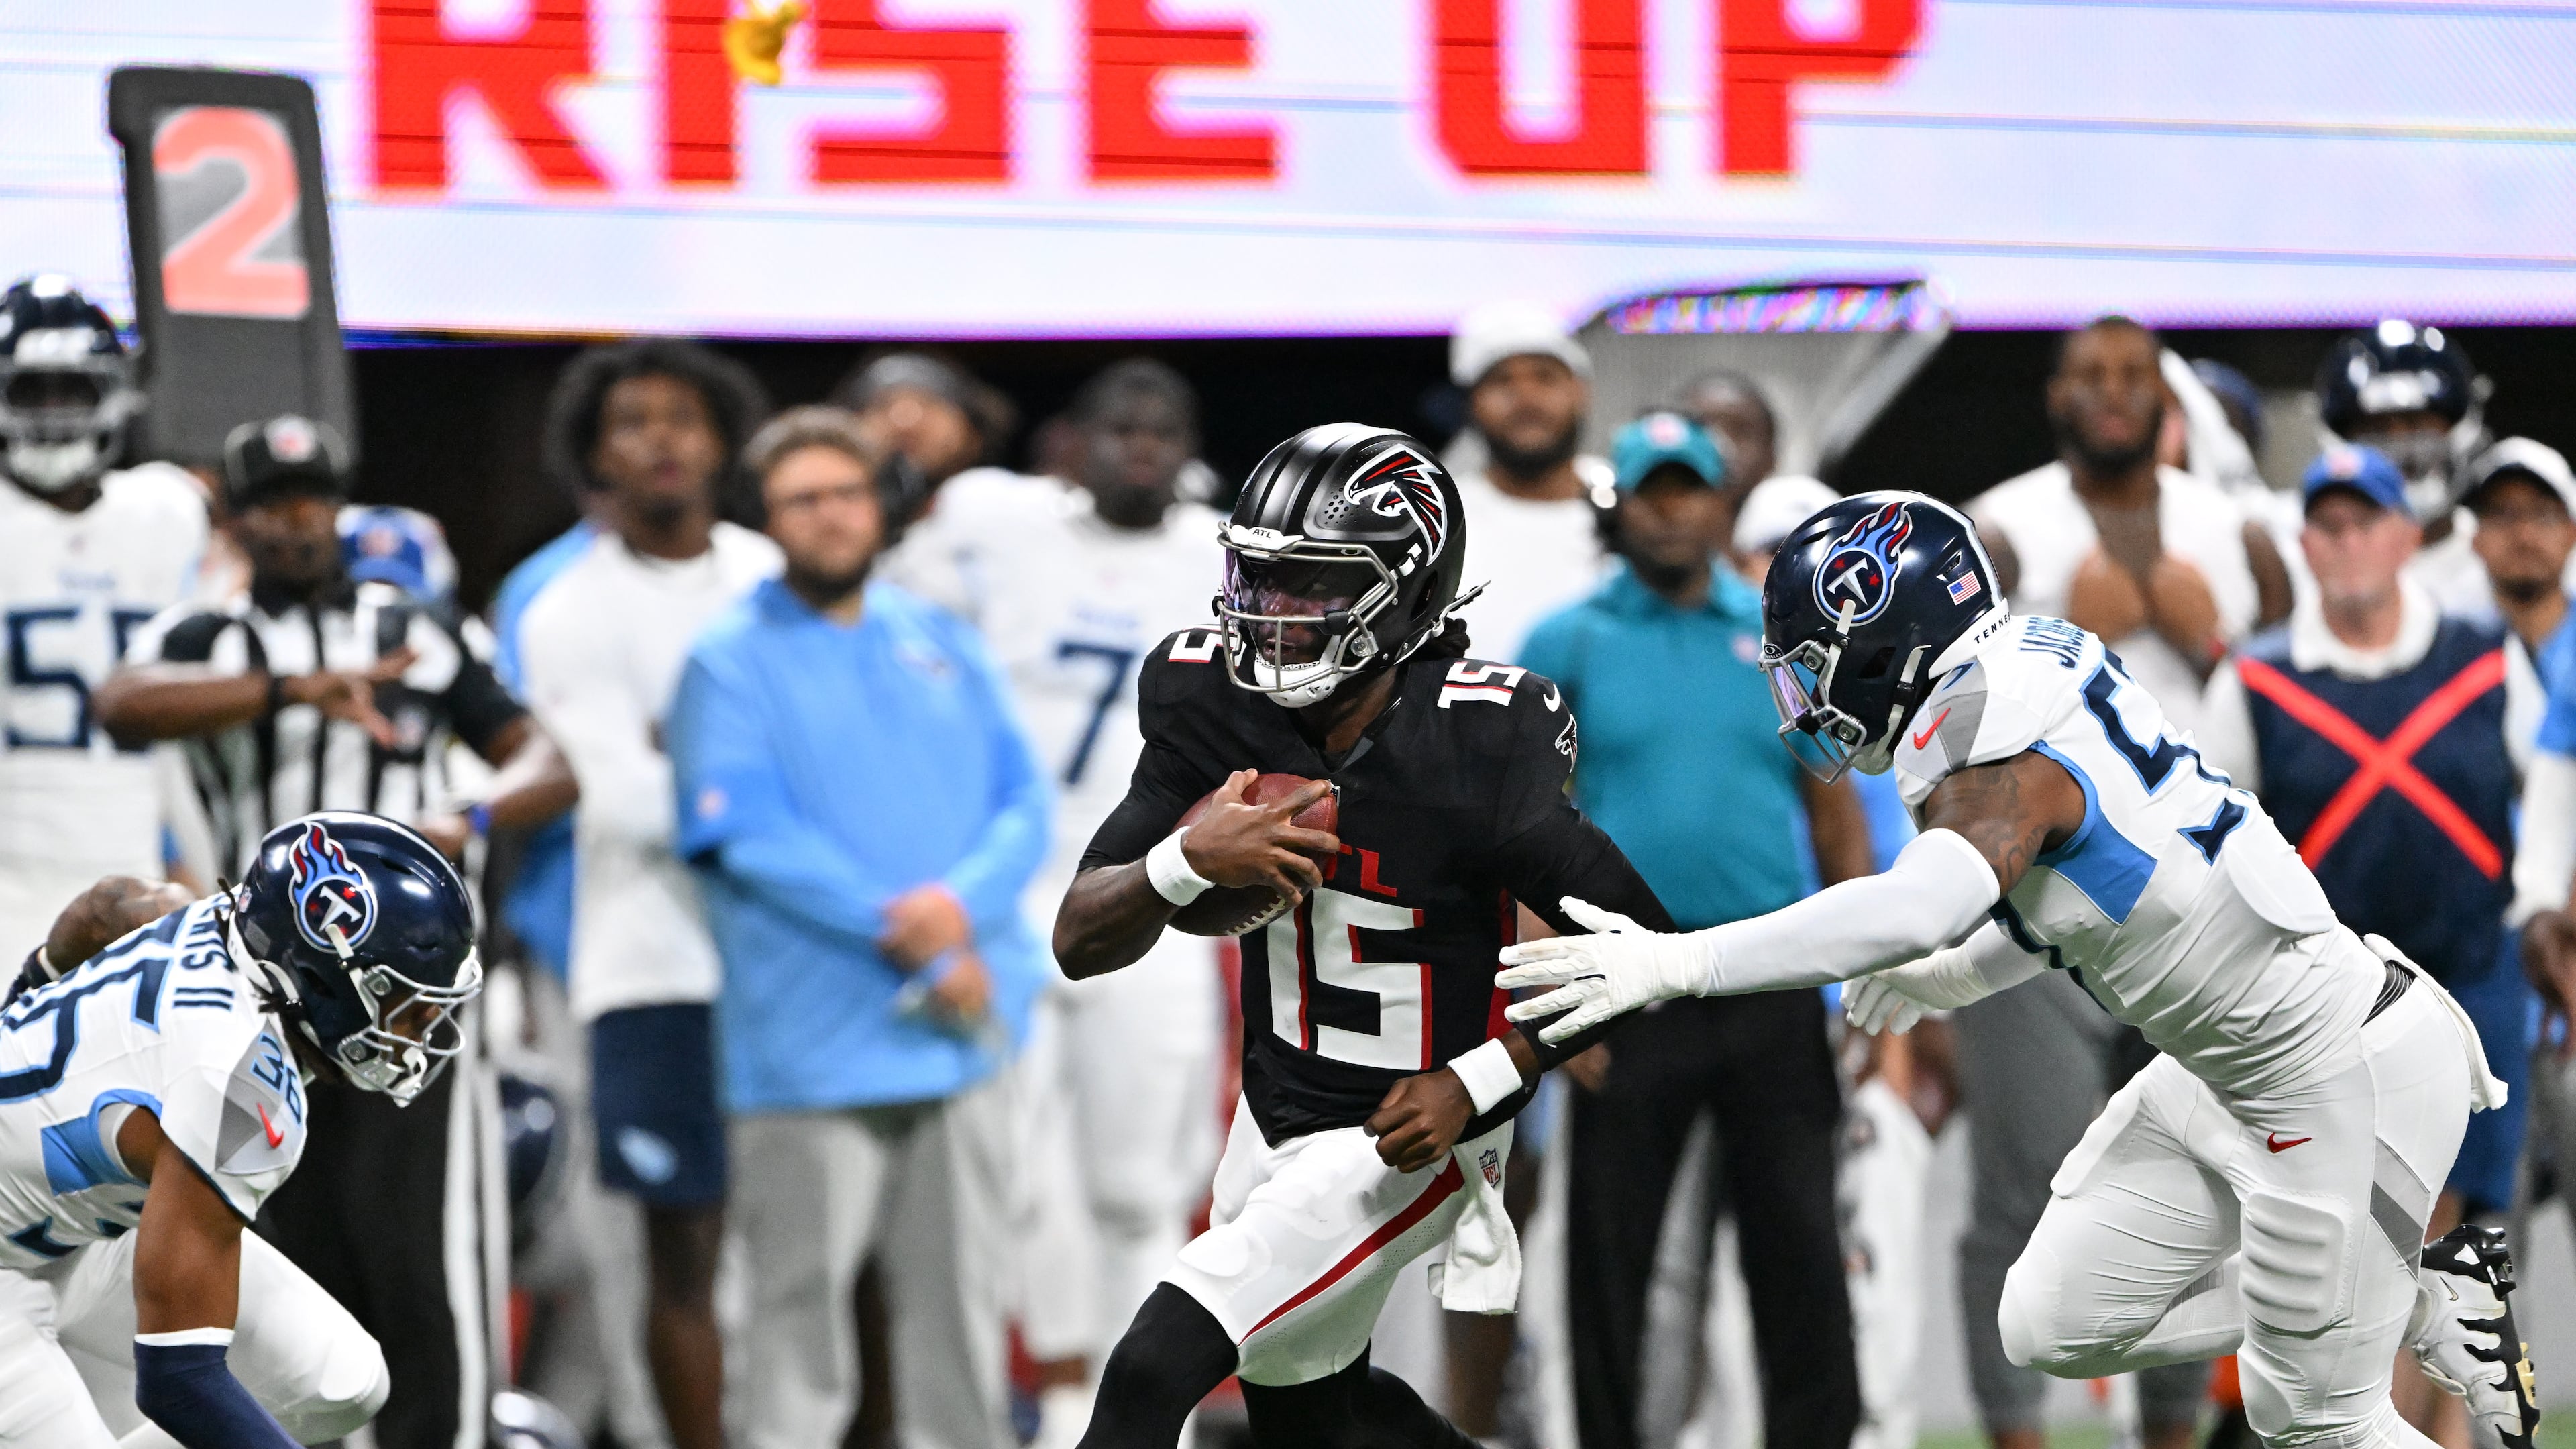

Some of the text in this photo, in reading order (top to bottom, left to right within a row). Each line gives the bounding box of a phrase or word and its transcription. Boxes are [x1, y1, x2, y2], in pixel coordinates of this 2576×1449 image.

[371, 0, 1923, 188] RISE UP
[153, 105, 311, 317] 2
[1252, 529, 1271, 539] ATL
[1437, 661, 1527, 709] 15
[1267, 888, 1432, 1071] 15
